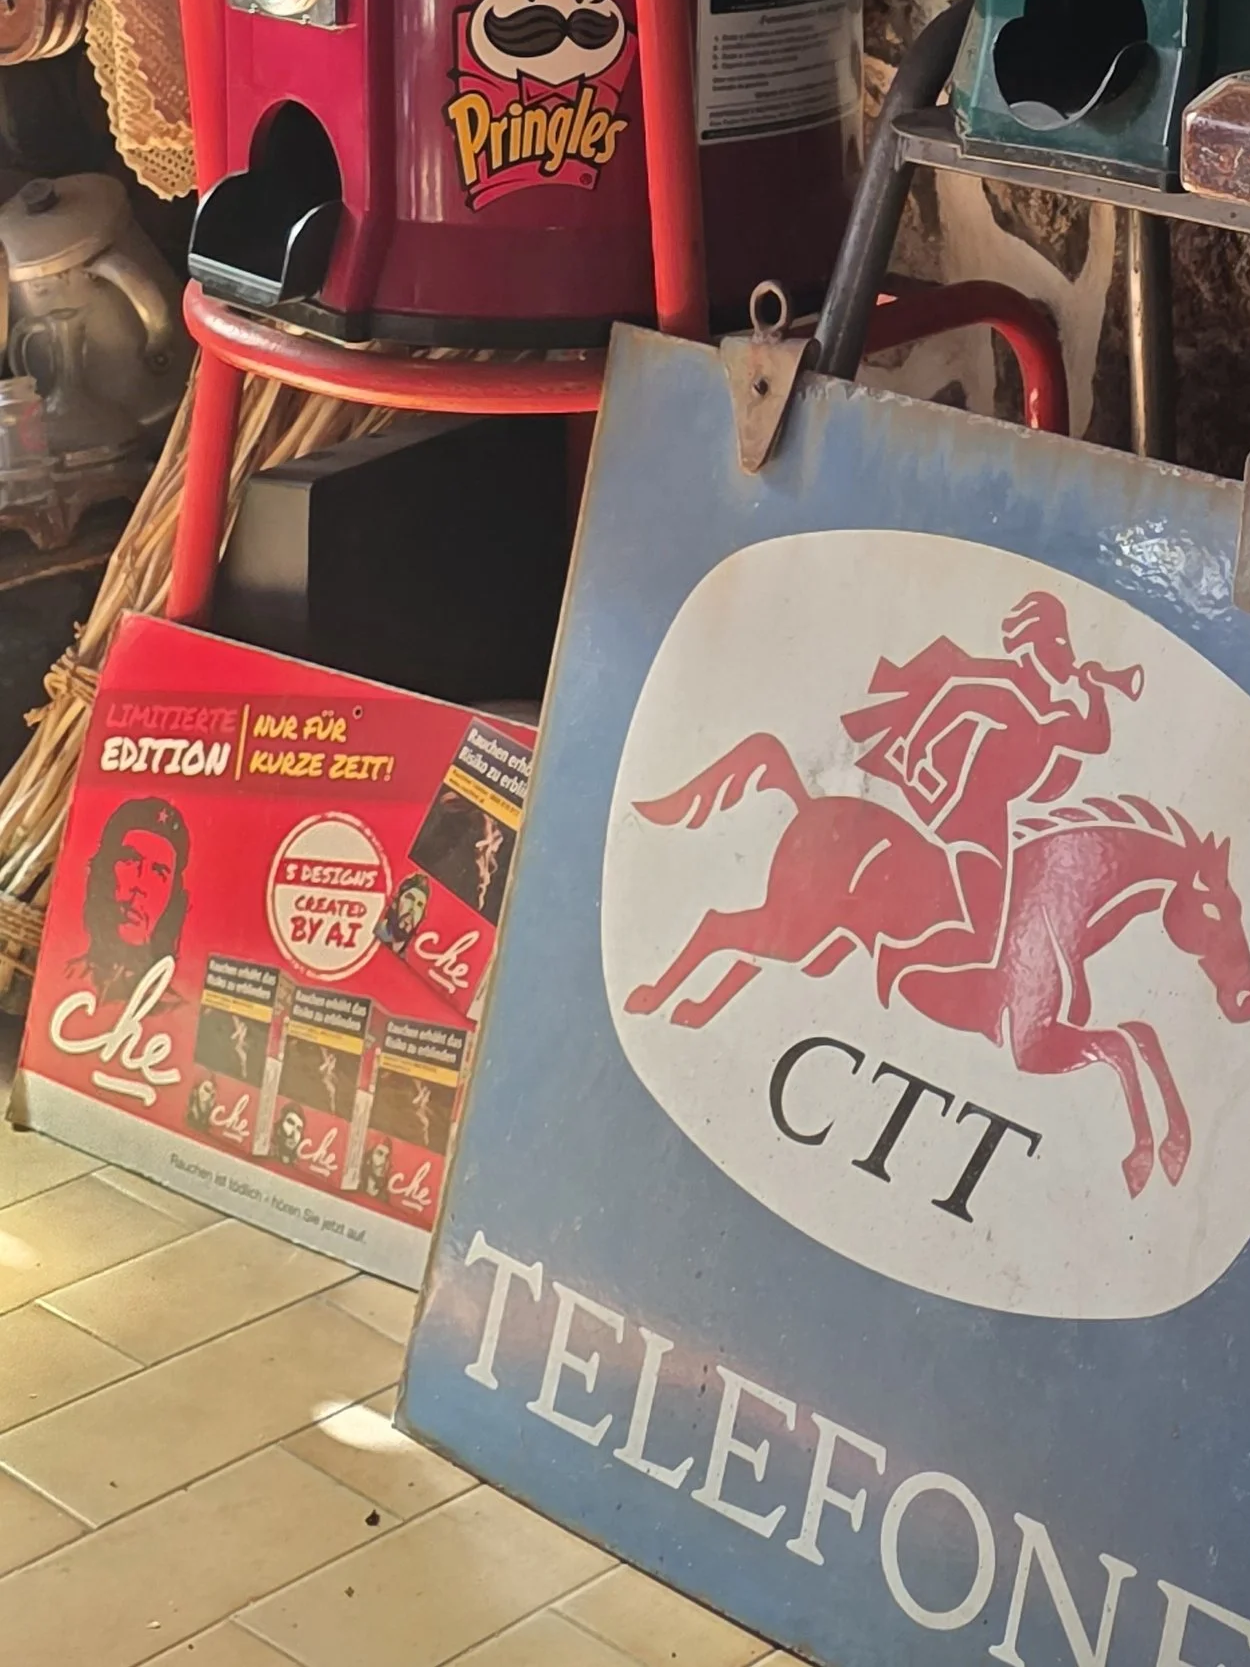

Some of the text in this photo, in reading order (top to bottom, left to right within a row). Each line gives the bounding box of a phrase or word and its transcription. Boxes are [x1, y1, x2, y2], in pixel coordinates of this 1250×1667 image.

[447, 87, 629, 186] Pringles
[105, 703, 238, 733] LIMITIERTE
[253, 709, 348, 743] NUR FÜR
[100, 736, 231, 777] EDITION
[467, 727, 509, 764] Rauchen
[250, 750, 395, 782] KURZE ZEIT!
[458, 746, 488, 776] Risiko
[486, 764, 501, 783] zu
[285, 866, 378, 889] 5 DESIGNS
[294, 895, 368, 919] CREATED
[290, 916, 364, 949] BY AI
[767, 1036, 1043, 1224] CTT
[170, 1153, 213, 1181] Rauchen
[214, 1173, 227, 1188] ist
[227, 1176, 263, 1204] tödlich
[271, 1196, 301, 1218] hören
[302, 1207, 322, 1225] Sie
[320, 1218, 346, 1235] jetzt
[347, 1226, 368, 1244] auf.
